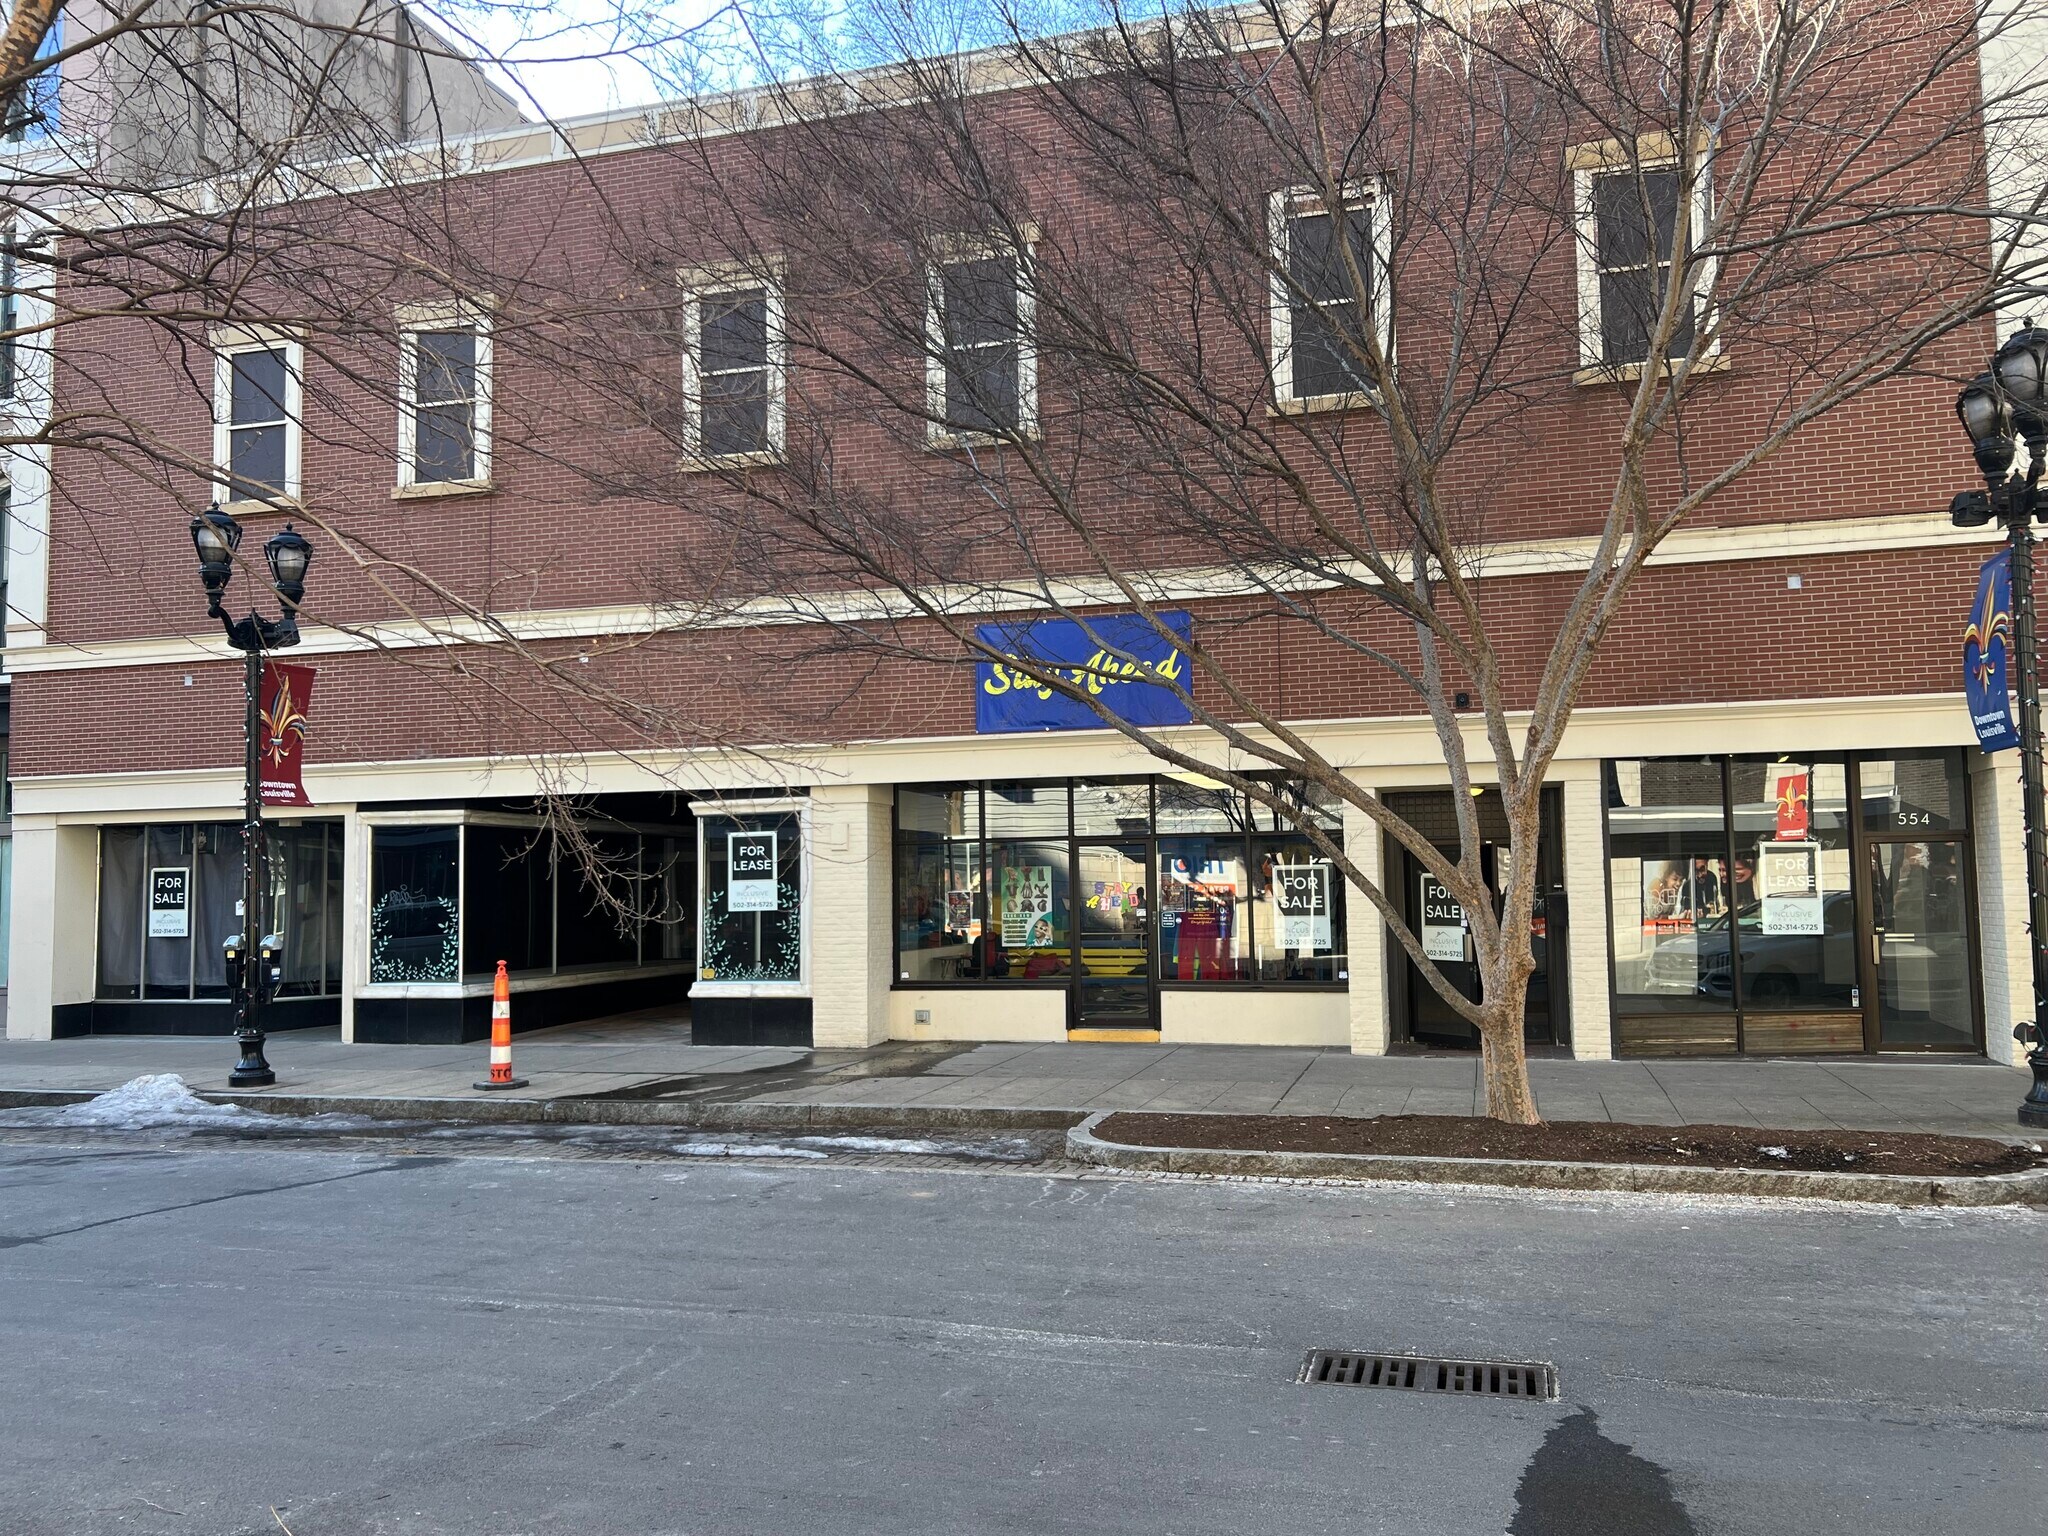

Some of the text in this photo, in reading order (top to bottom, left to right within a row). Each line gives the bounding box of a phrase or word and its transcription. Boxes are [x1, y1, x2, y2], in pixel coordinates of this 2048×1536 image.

[1974, 710, 2006, 726] Downtown
[1978, 723, 2006, 738] Louisville
[1897, 812, 1930, 825] 554
[739, 845, 765, 856] FOR
[733, 860, 772, 871] LEASE
[1775, 858, 1807, 870] FOR
[157, 877, 182, 889] FOR
[1284, 877, 1319, 890] FOR
[1768, 875, 1815, 887] LEASE
[1094, 881, 1133, 896] STAY
[154, 892, 184, 904] SALE
[1086, 893, 1139, 913] AHEAD
[1280, 895, 1323, 908] SALE
[1426, 904, 1460, 919] SALE
[1768, 923, 1818, 931] 502-314-5725
[1426, 949, 1463, 958] 502-314-5725
